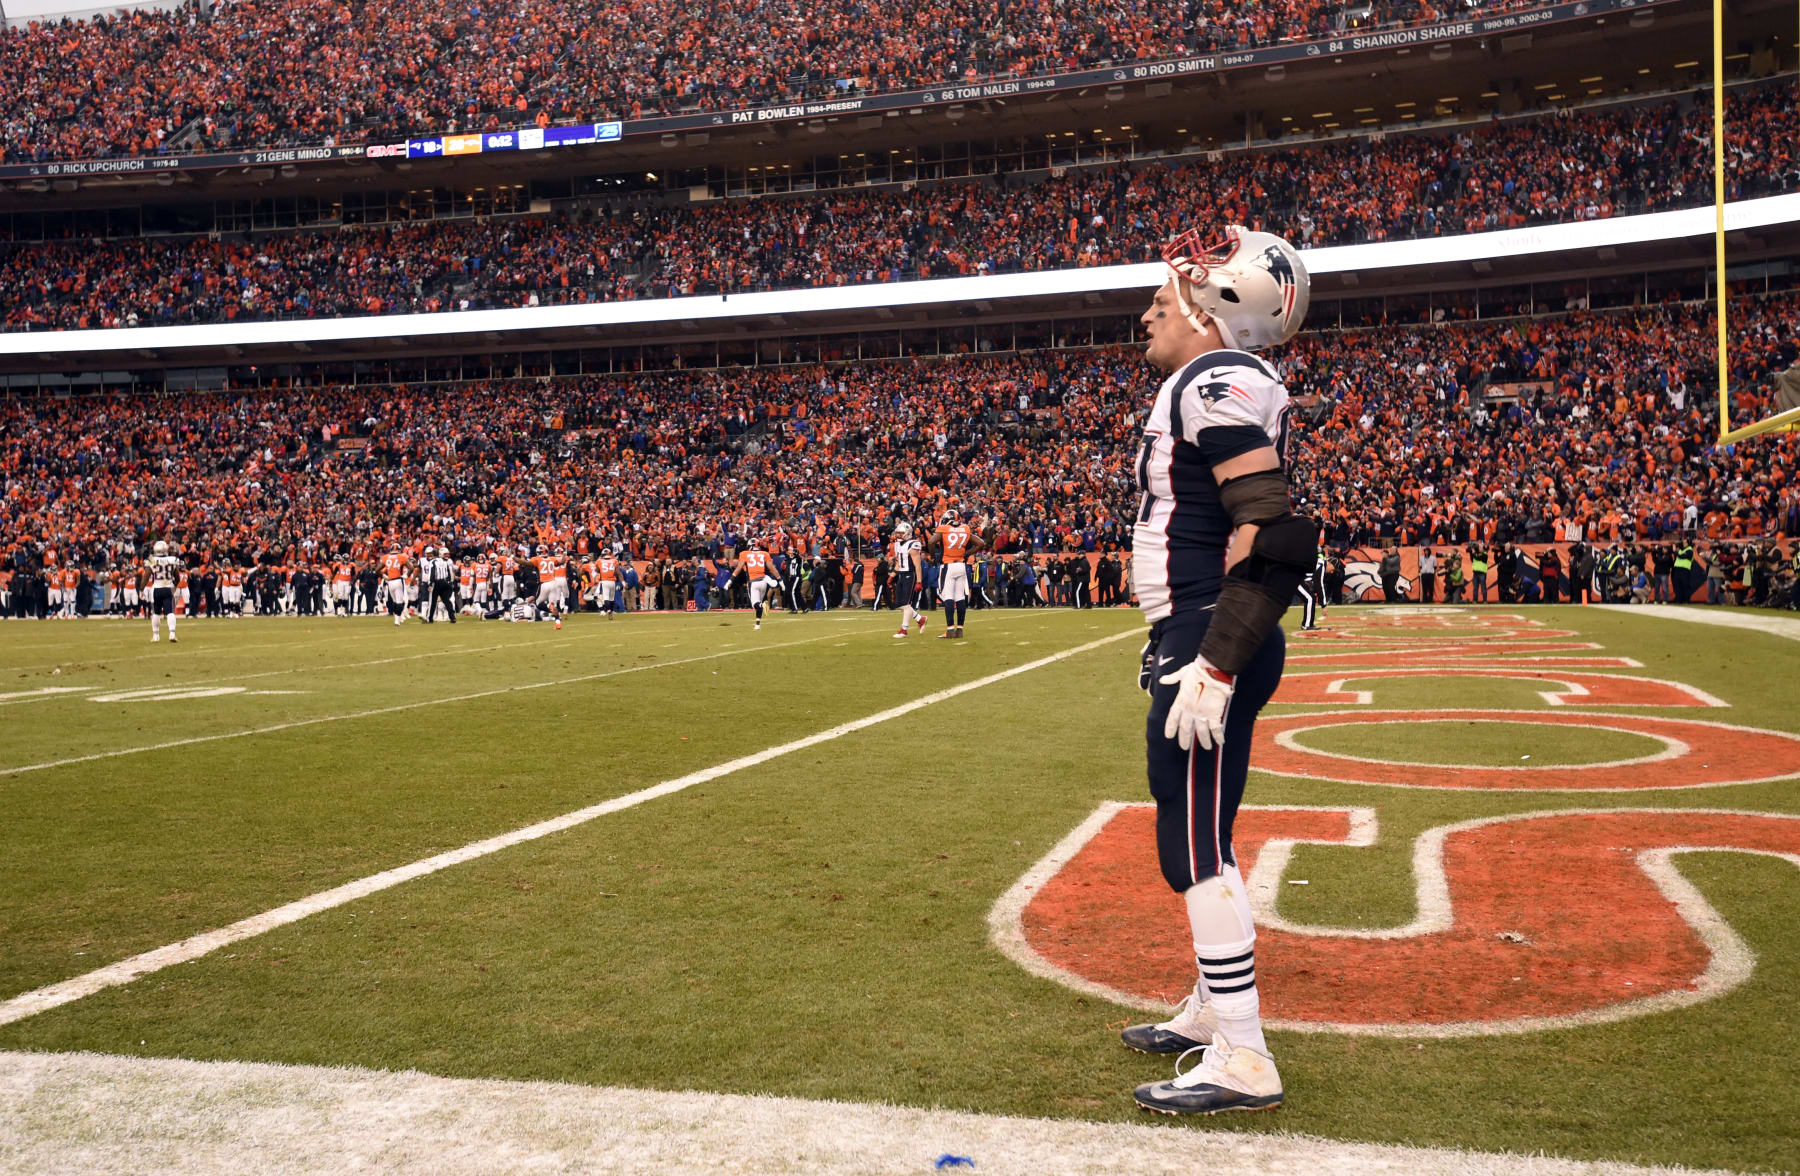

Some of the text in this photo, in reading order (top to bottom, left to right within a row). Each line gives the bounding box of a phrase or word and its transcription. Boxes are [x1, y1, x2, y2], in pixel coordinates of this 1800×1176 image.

[1329, 11, 1553, 52] 84 SHANNON SHARPE 1990-99, 2002-03
[1133, 67, 1147, 77] 80
[1150, 63, 1175, 75] ROD
[1178, 58, 1215, 72] SMITH
[941, 90, 954, 100] 66
[957, 88, 980, 99] TOM
[983, 82, 1020, 96] NALEN
[732, 100, 862, 123] PAT BOWLEN 1984-PRESENT
[255, 152, 266, 162] 21
[268, 150, 295, 162] GENE
[297, 148, 332, 160] MINGO
[367, 144, 406, 158] GMC
[47, 165, 59, 174] 80
[63, 162, 87, 173] RICK
[89, 160, 144, 172] UPCHURCH
[947, 533, 968, 550] 97
[385, 559, 400, 569] 94
[540, 560, 555, 574] 20
[746, 553, 765, 567] 33
[153, 564, 174, 580] 28
[476, 567, 489, 578] 25
[601, 563, 615, 573] 54
